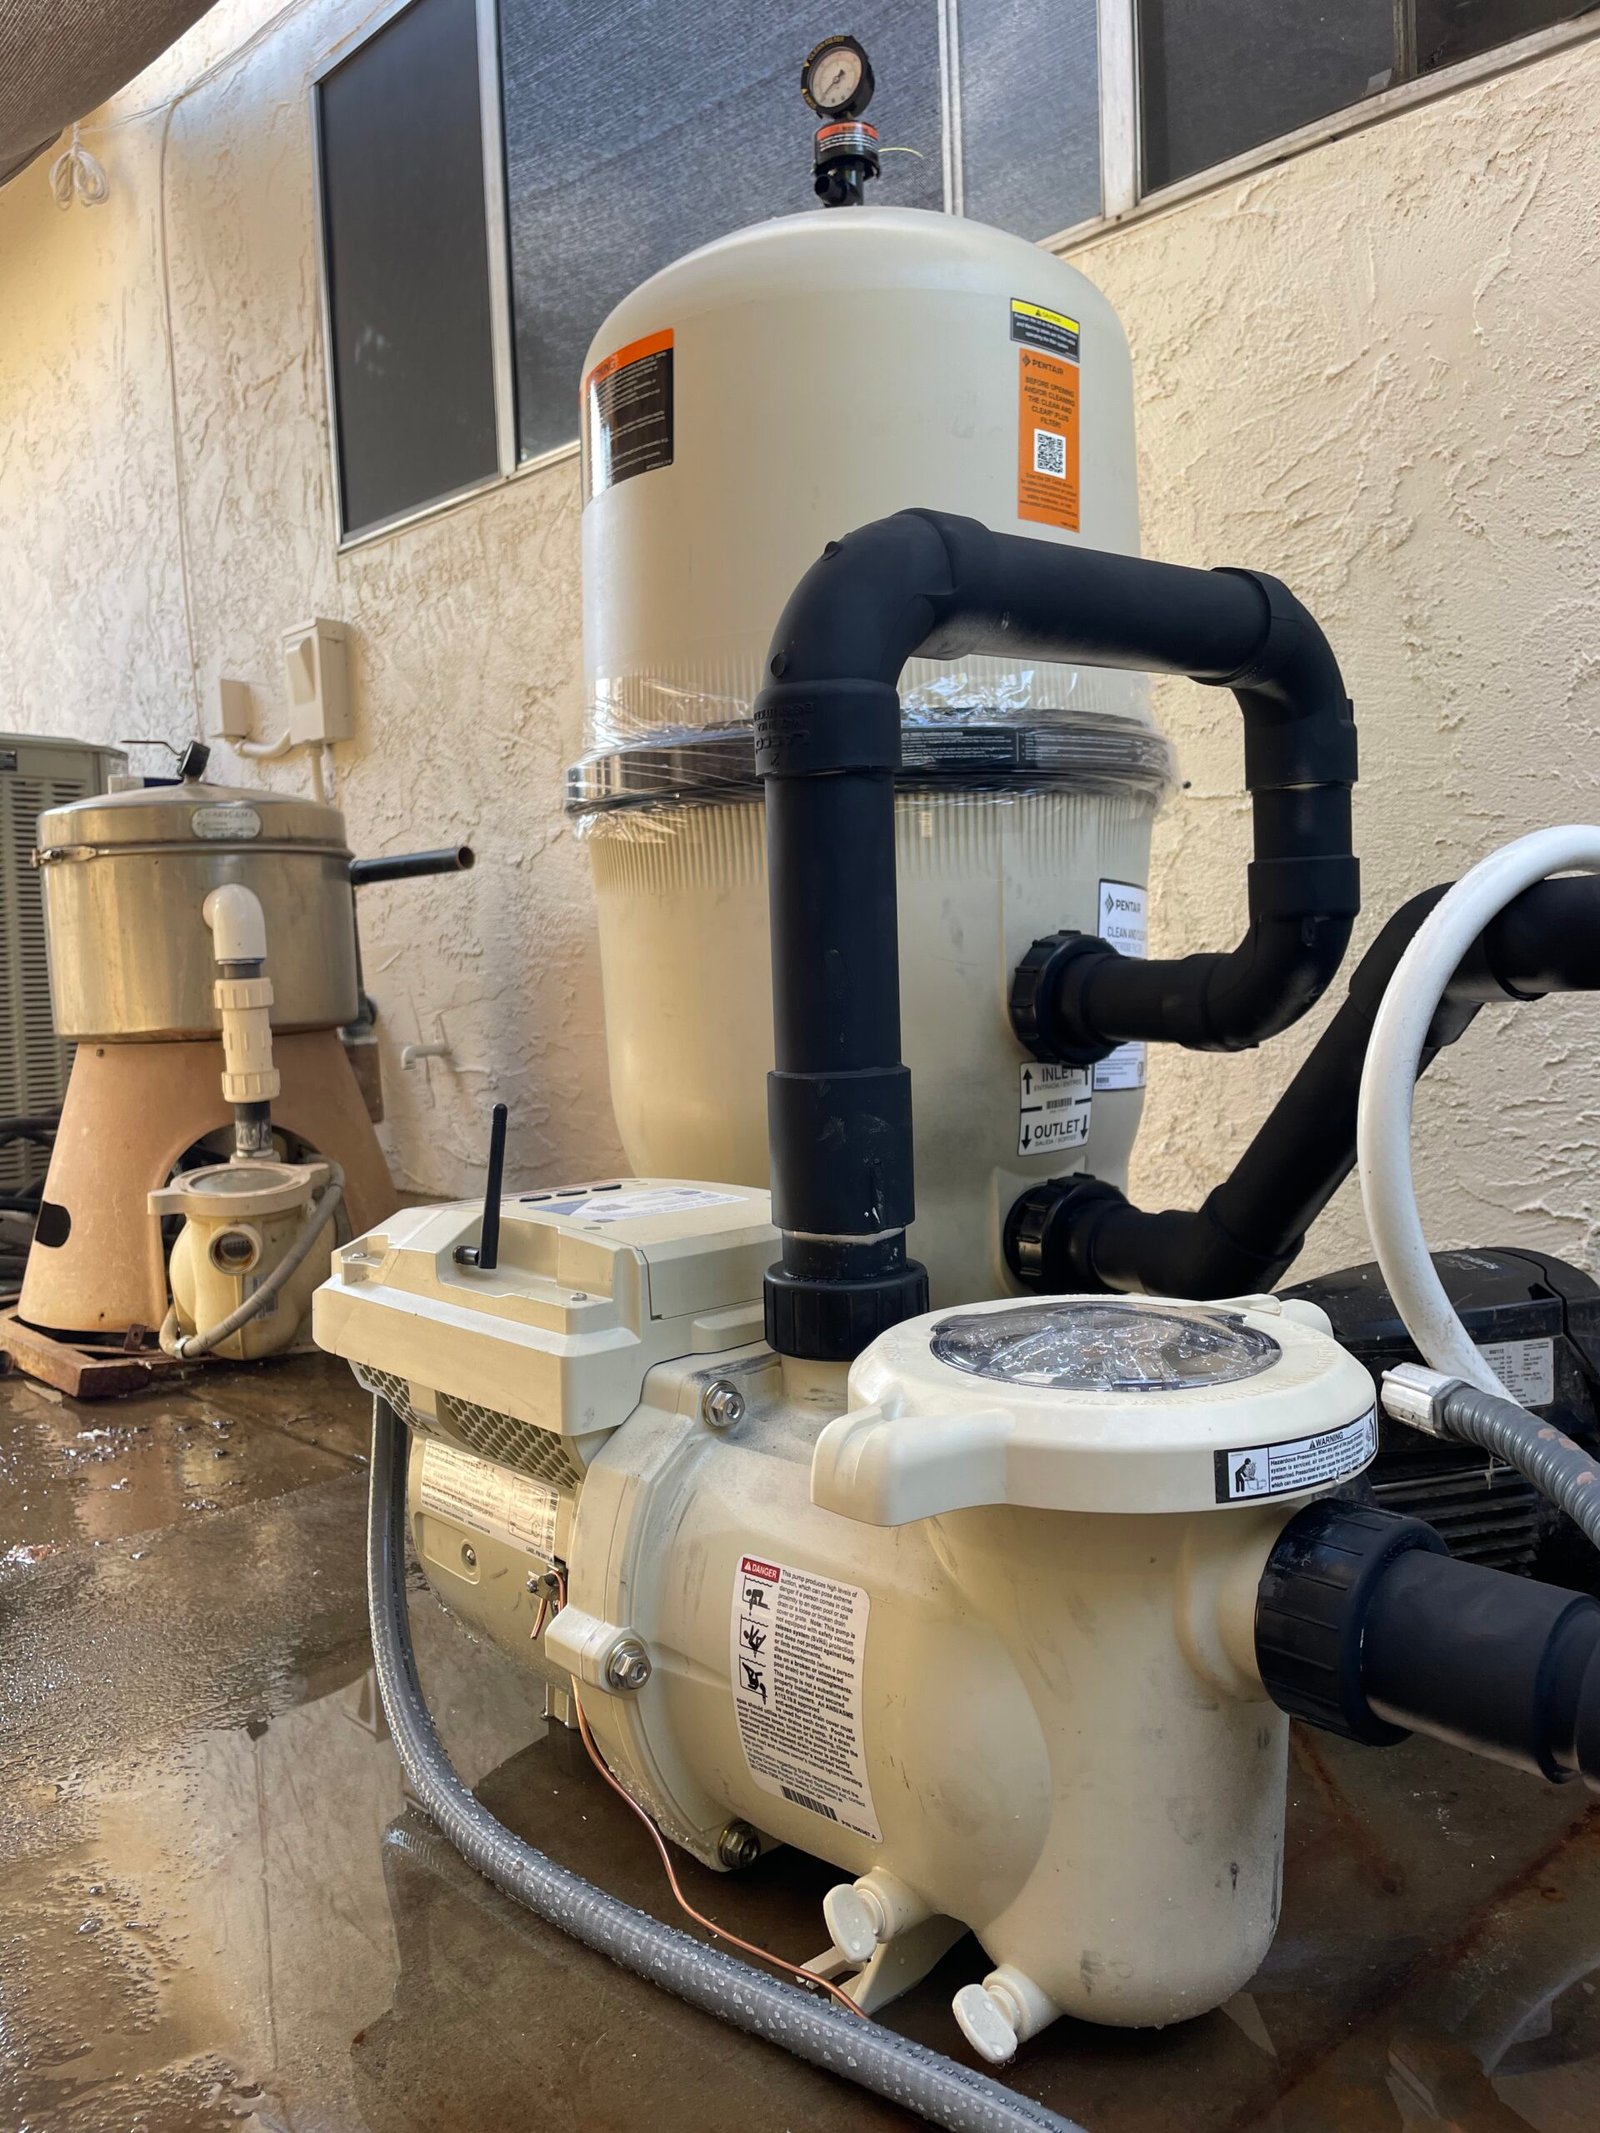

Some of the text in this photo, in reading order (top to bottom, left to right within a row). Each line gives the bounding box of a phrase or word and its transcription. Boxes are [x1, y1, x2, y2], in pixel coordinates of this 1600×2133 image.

[1032, 360, 1064, 374] PENTAIR
[1026, 377, 1074, 397] BEFORE OPENING
[1049, 392, 1075, 406] CLEANING
[1028, 395, 1072, 414] THE CLEAN AND
[1107, 926, 1127, 938] CLEAN
[1034, 1119, 1080, 1139] OUTLET
[1315, 1431, 1344, 1447] WARNING
[1271, 1458, 1296, 1466] Hazardous
[752, 1563, 777, 1578] DANGER
[782, 1569, 791, 1578] This
[792, 1572, 805, 1582] pump
[805, 1577, 826, 1588] produces
[827, 1583, 836, 1592] high
[838, 1587, 851, 1597] levels
[780, 1586, 794, 1595] danger
[803, 1593, 818, 1604] person
[820, 1597, 835, 1608] comes
[841, 1604, 853, 1614] close
[781, 1578, 797, 1588] suction,
[799, 1583, 811, 1591] which
[821, 1590, 832, 1599] pose
[833, 1594, 852, 1605] extreme
[778, 1593, 798, 1604] proximity
[811, 1603, 822, 1613] open
[823, 1607, 833, 1617] pool
[840, 1613, 848, 1621] spa
[778, 1601, 788, 1610] drain
[799, 1607, 811, 1616] loose
[817, 1612, 833, 1624] broken
[834, 1617, 846, 1627] drain
[777, 1609, 788, 1617] cover
[810, 1619, 823, 1628] Note:
[824, 1622, 835, 1632] This
[836, 1626, 849, 1636] pump
[785, 1619, 806, 1631] equipped
[807, 1625, 817, 1633] with
[818, 1629, 833, 1640] safety
[834, 1636, 853, 1646] vacuum
[775, 1623, 792, 1633] release
[793, 1628, 809, 1639] system
[829, 1641, 854, 1655] protection
[775, 1631, 784, 1639] and
[806, 1641, 823, 1652] protect
[824, 1648, 841, 1659] against
[843, 1655, 855, 1665] body
[780, 1640, 790, 1648] limb
[774, 1646, 816, 1665] disembowelments
[817, 1660, 831, 1671] (when
[837, 1668, 854, 1679] person
[774, 1661, 784, 1669] pool
[785, 1664, 798, 1675] drain)
[805, 1671, 815, 1680] hair
[794, 1660, 811, 1671] broken
[818, 1669, 843, 1683] uncovered
[774, 1669, 784, 1677] This
[785, 1674, 798, 1684] pump
[817, 1685, 841, 1699] substitute
[774, 1678, 845, 1708] properly installed and secured
[775, 1700, 853, 1733] anti-entrapment drain cover must
[785, 1688, 797, 1697] drain
[798, 1694, 815, 1704] covers.
[826, 1704, 854, 1719] ANSI/ASME
[798, 1700, 820, 1713] approved
[748, 1701, 763, 1712] should
[787, 1718, 802, 1727] drains
[838, 1739, 850, 1747] drain
[783, 1709, 794, 1717] used
[831, 1727, 844, 1737] Pools
[846, 1734, 855, 1742] and
